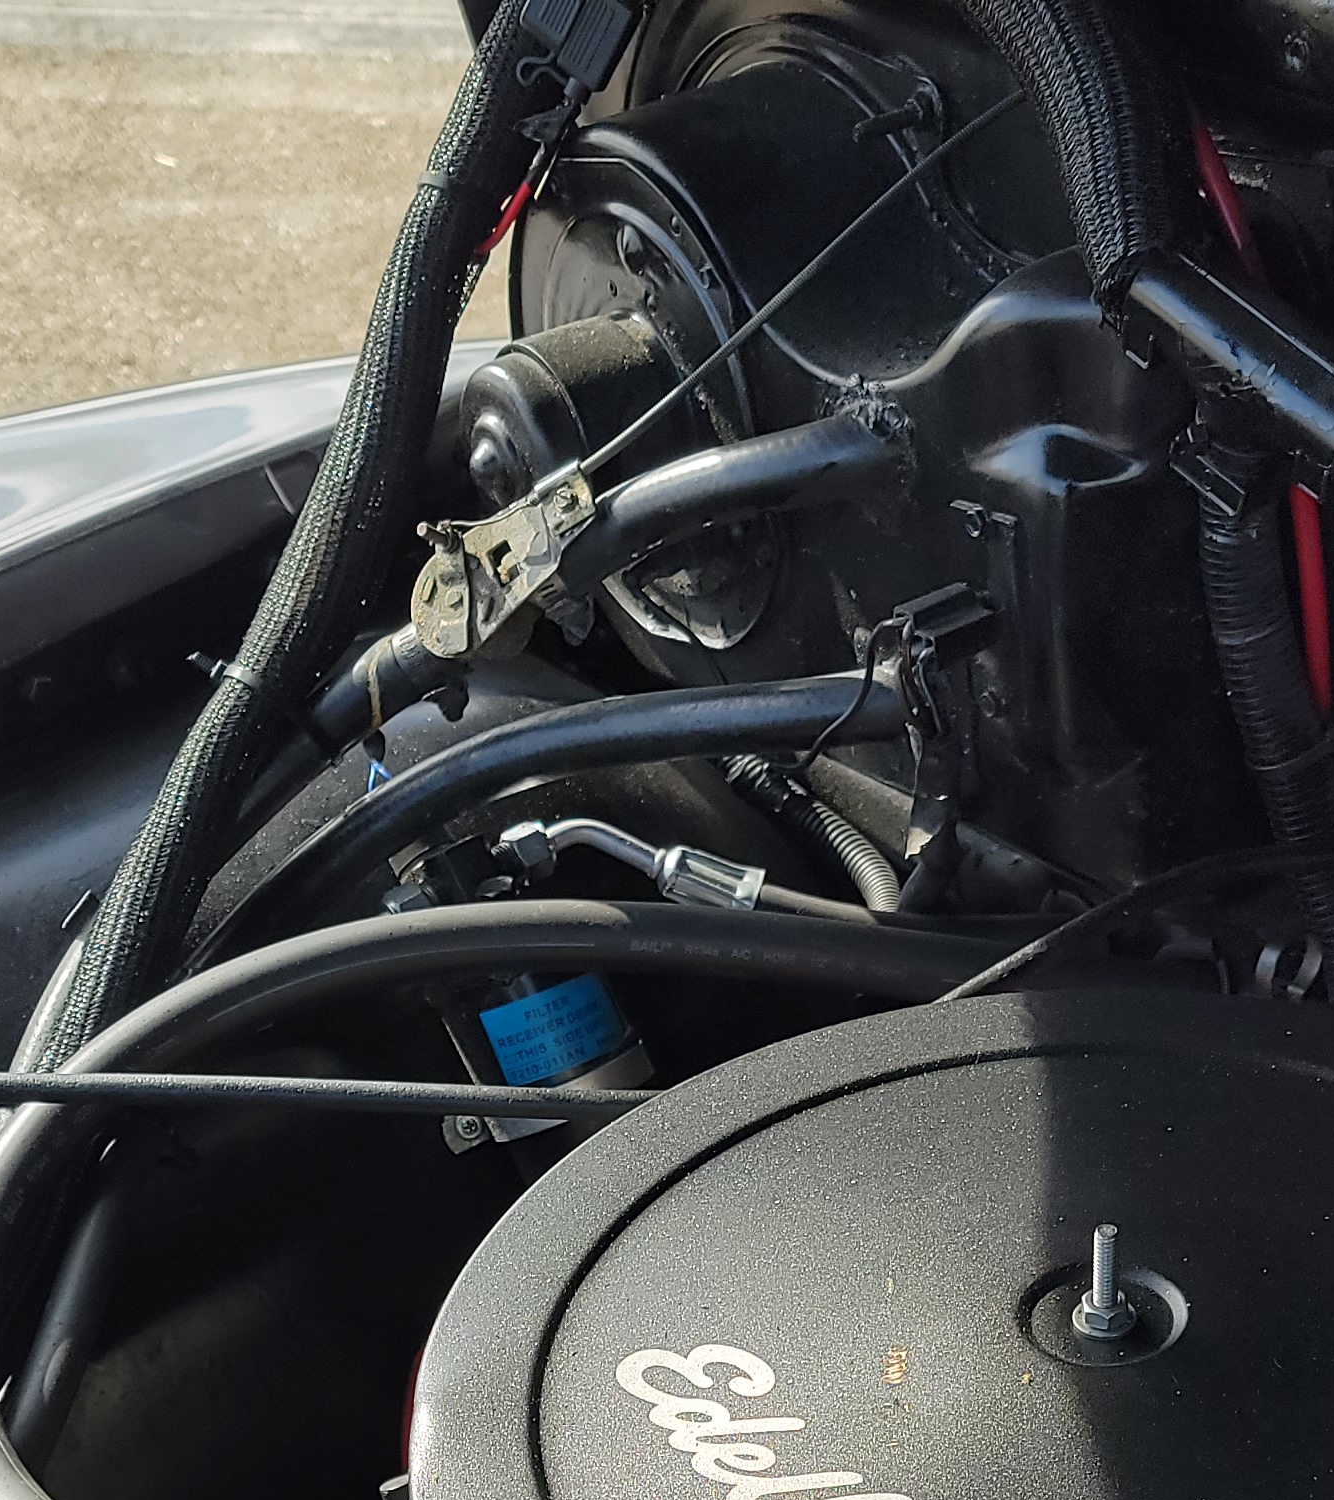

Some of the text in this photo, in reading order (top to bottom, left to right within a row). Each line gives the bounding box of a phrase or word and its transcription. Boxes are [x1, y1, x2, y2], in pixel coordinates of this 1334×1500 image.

[524, 996, 569, 1022] FILTER
[497, 1017, 565, 1049] RECEIVER
[516, 1042, 548, 1060] THIS
[553, 1027, 584, 1047] SIDE
